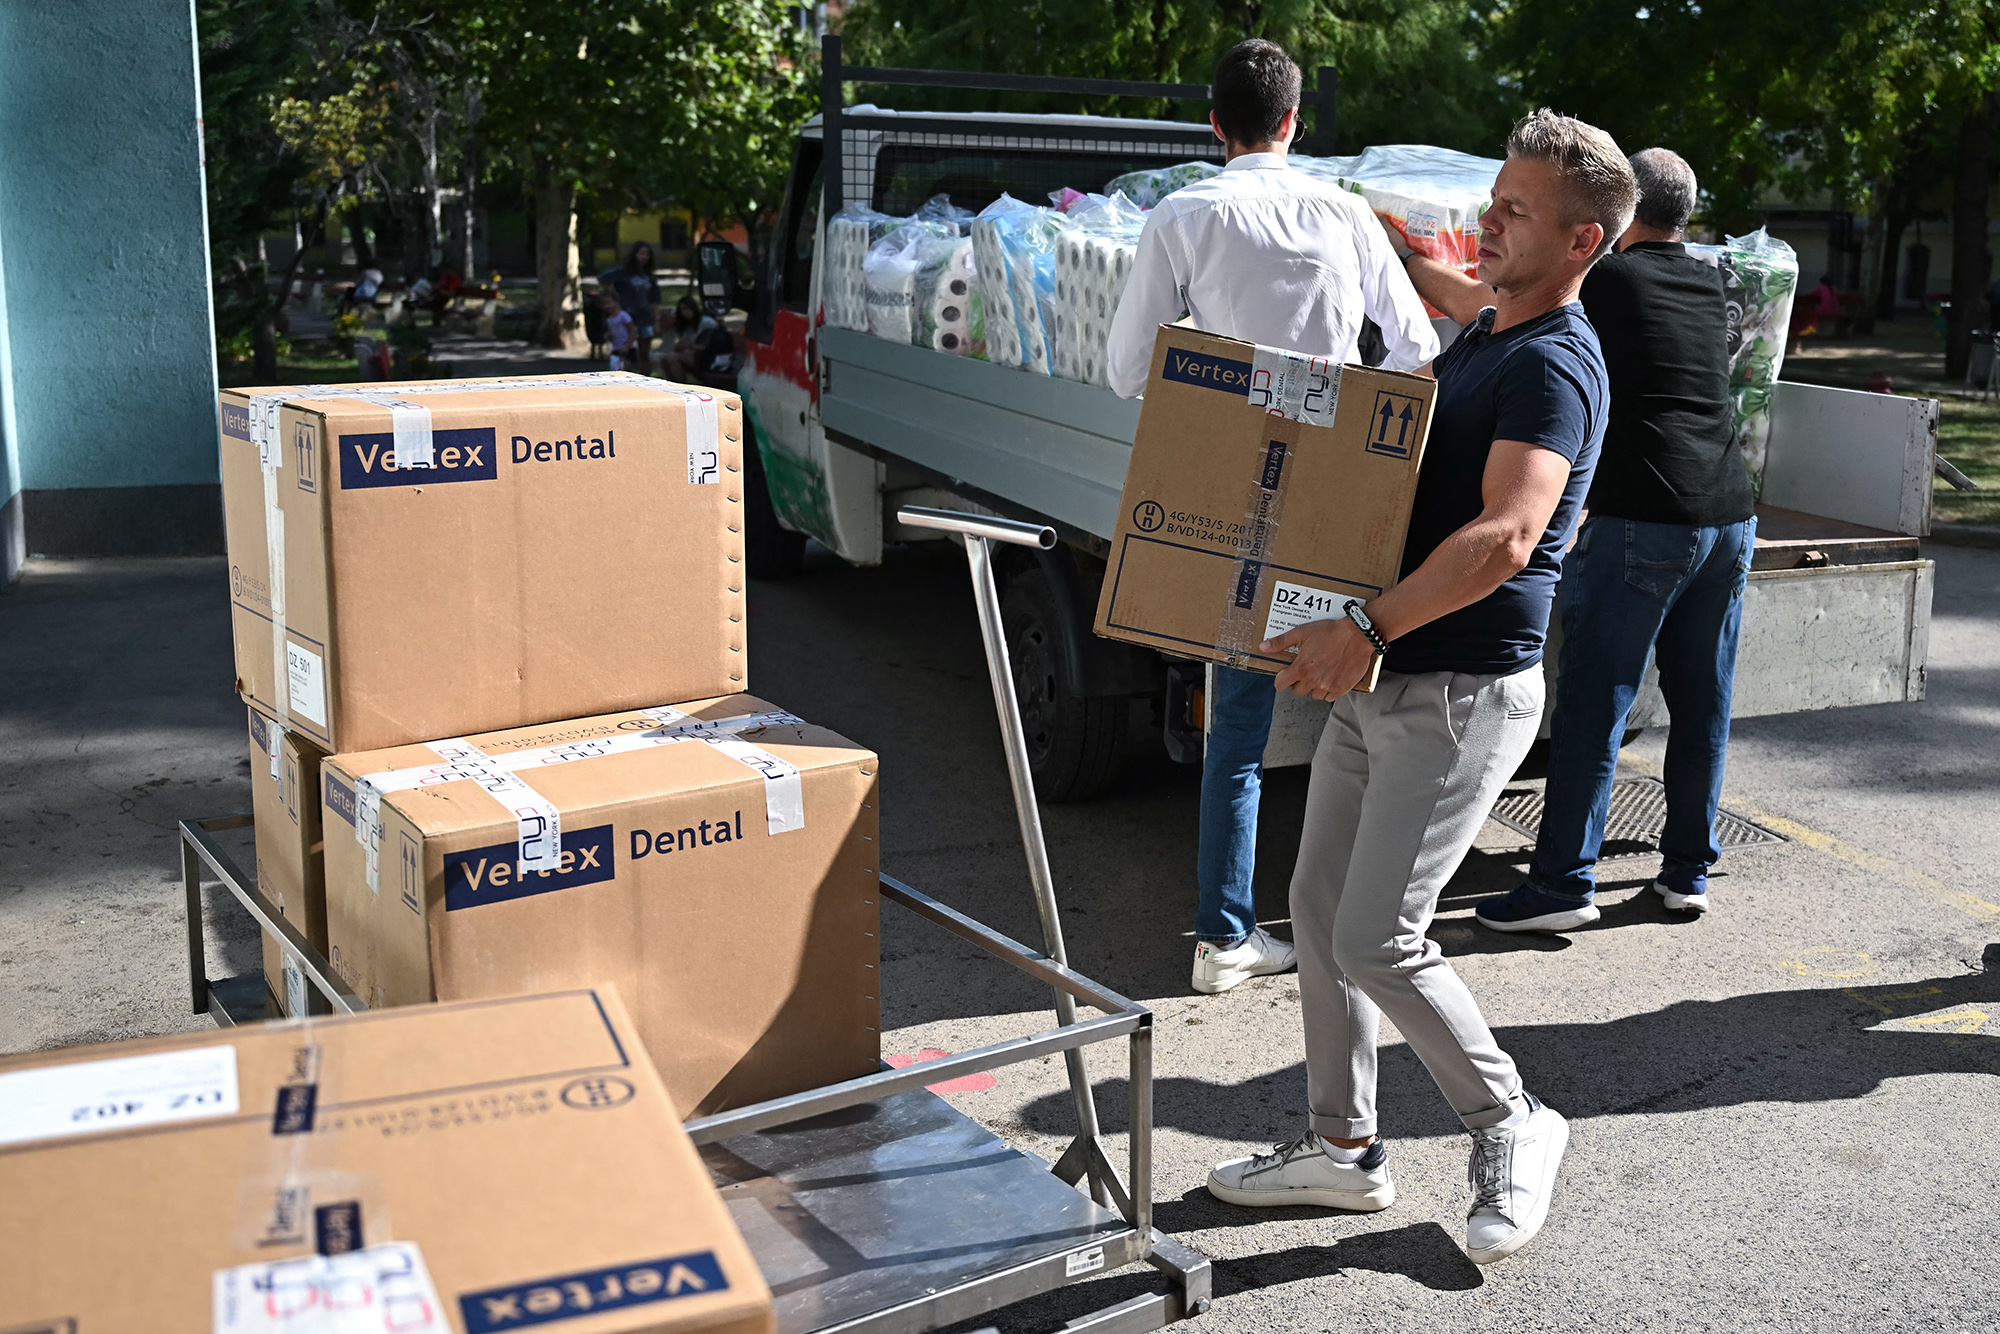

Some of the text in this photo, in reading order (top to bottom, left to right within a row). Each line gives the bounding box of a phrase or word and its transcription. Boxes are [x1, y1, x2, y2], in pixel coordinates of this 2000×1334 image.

[1174, 355, 1249, 386] Vertex
[1331, 383, 1339, 400] YORK
[1328, 402, 1336, 416] NEW
[354, 430, 616, 474] Veex Dental
[1265, 446, 1284, 486] Vertex
[1169, 510, 1224, 530] 4G/Y53/S
[1276, 588, 1332, 612] DZ 411
[289, 651, 298, 669] DZ
[328, 780, 356, 818] Vertex
[460, 811, 744, 892] Veex Dental
[482, 1261, 707, 1325] Vertex
